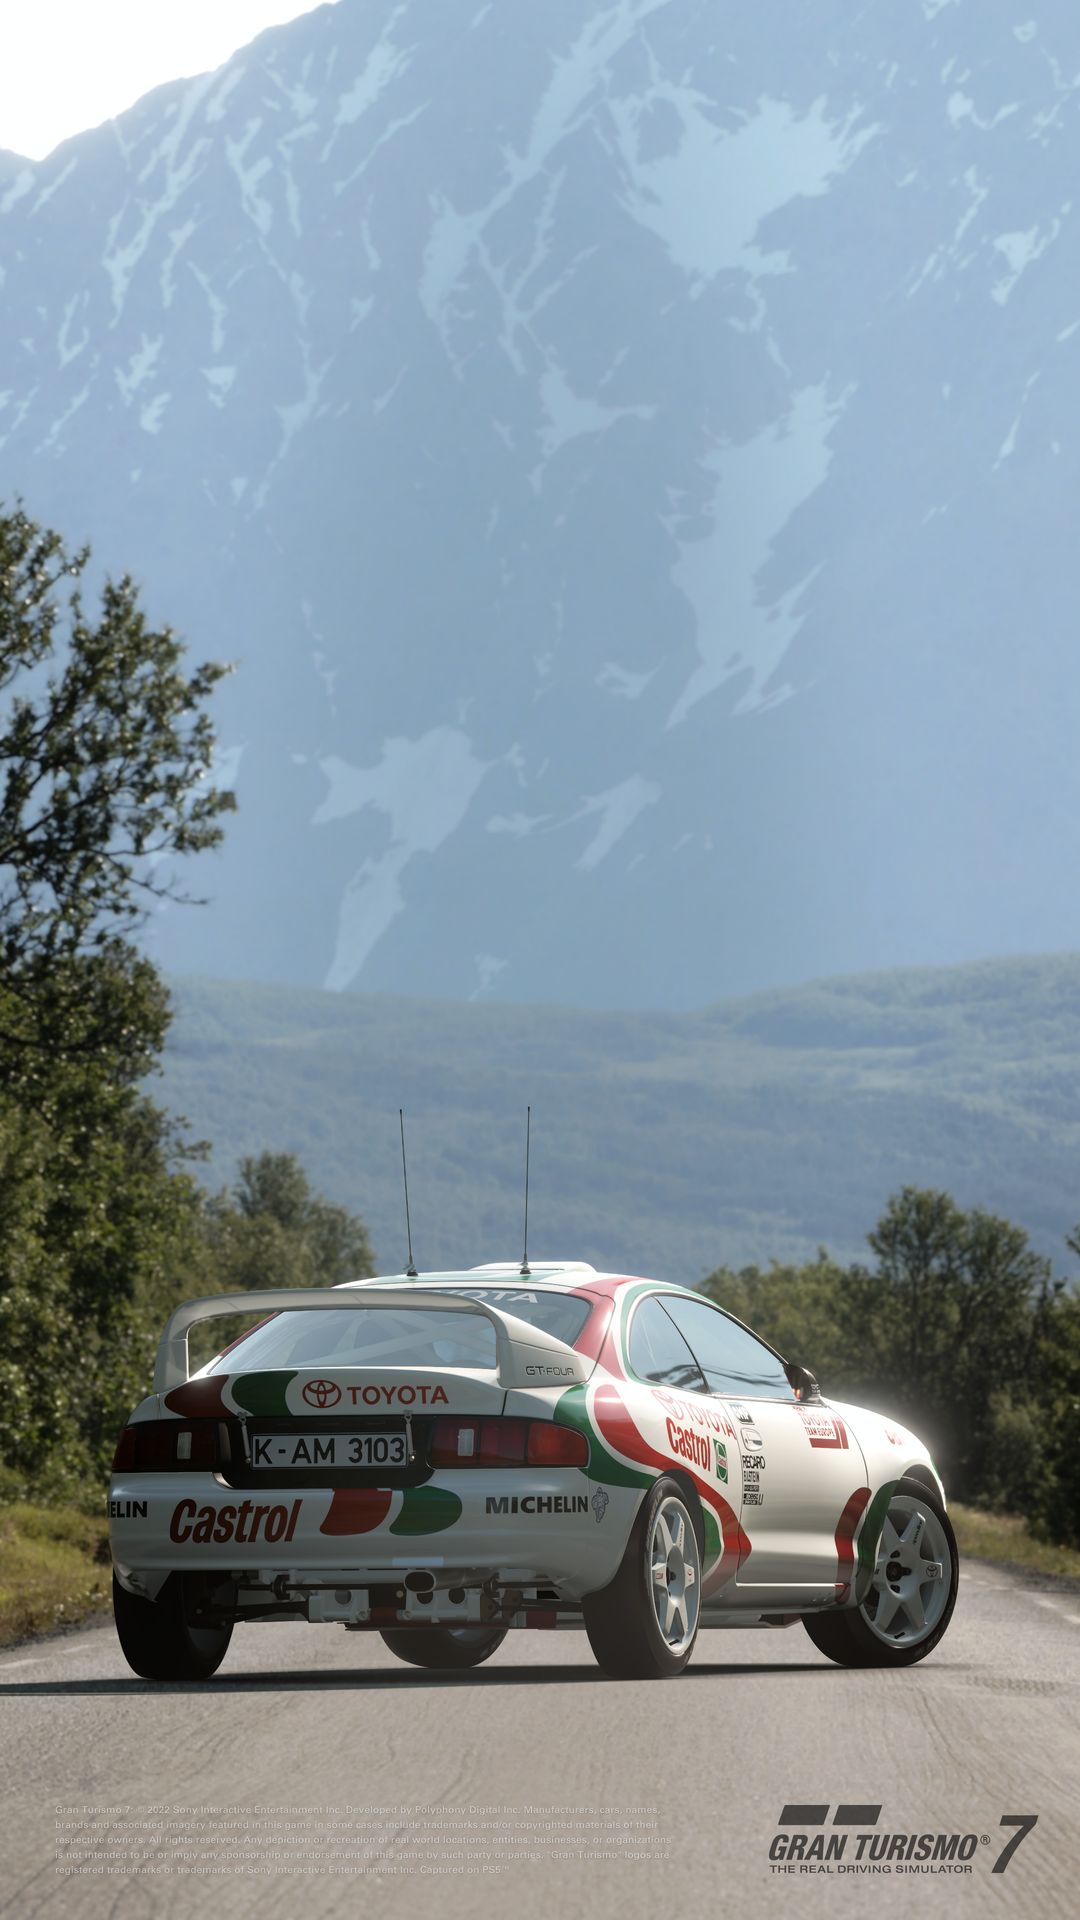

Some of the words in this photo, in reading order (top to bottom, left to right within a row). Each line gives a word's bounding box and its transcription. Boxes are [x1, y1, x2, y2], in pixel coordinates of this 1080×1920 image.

[347, 1385, 449, 1405] TOYOTA
[678, 1399, 737, 1441] TOYOTA
[348, 1437, 405, 1464] 3103
[665, 1416, 711, 1472] Castrol
[742, 1454, 766, 1470] RECARO
[485, 1495, 589, 1514] MICHELIN
[169, 1498, 304, 1544] Castrol
